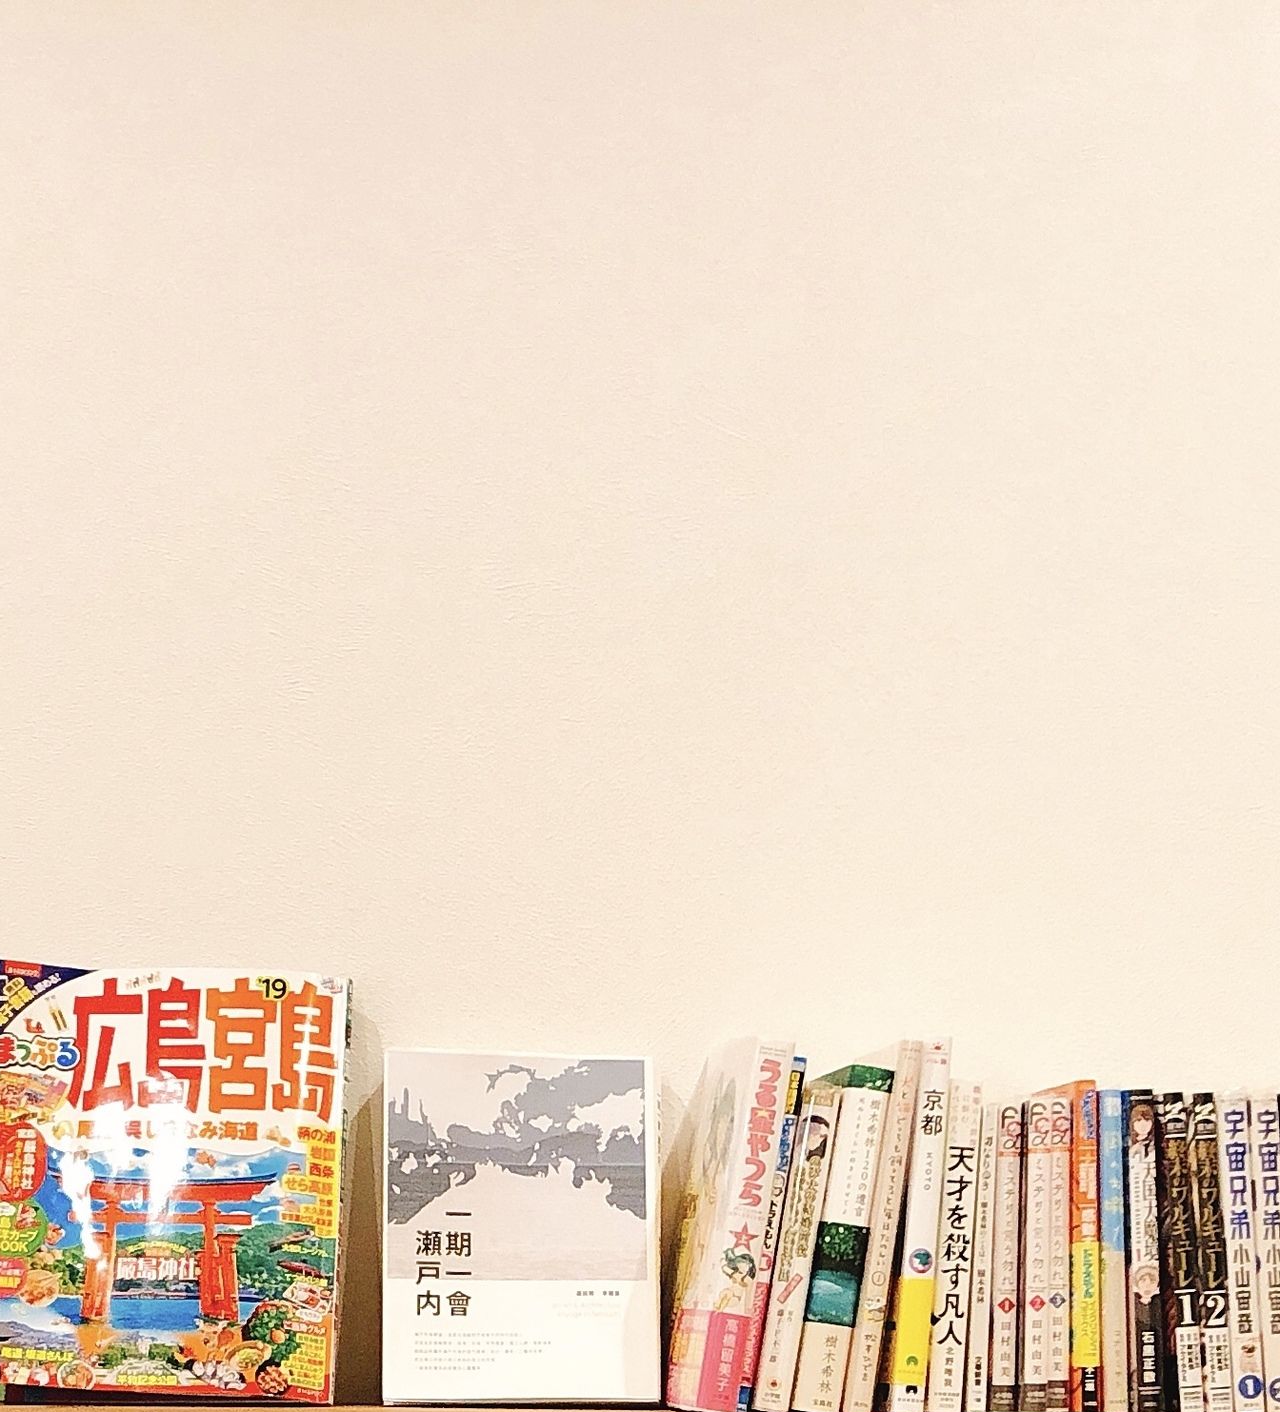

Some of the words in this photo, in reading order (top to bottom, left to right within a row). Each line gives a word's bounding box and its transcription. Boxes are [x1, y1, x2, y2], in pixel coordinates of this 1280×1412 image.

[256, 977, 287, 999] '19
[66, 976, 339, 1124] 広島宮島
[739, 1058, 782, 1207] うる星やつら
[920, 1089, 945, 1137] 京都
[924, 1152, 932, 1191] KYOTO
[1224, 1110, 1251, 1240] 宇宙兄弟
[415, 1230, 442, 1316] 瀬戸内
[445, 1211, 472, 1316] 一期一會
[936, 1145, 975, 1347] 天才を殺す凡人
[1179, 1295, 1195, 1326] 1
[1207, 1295, 1226, 1326] 2
[1233, 1243, 1254, 1334] 小山宙哉
[819, 1335, 838, 1393] 樹木希林
[1247, 1379, 1255, 1394] 1
